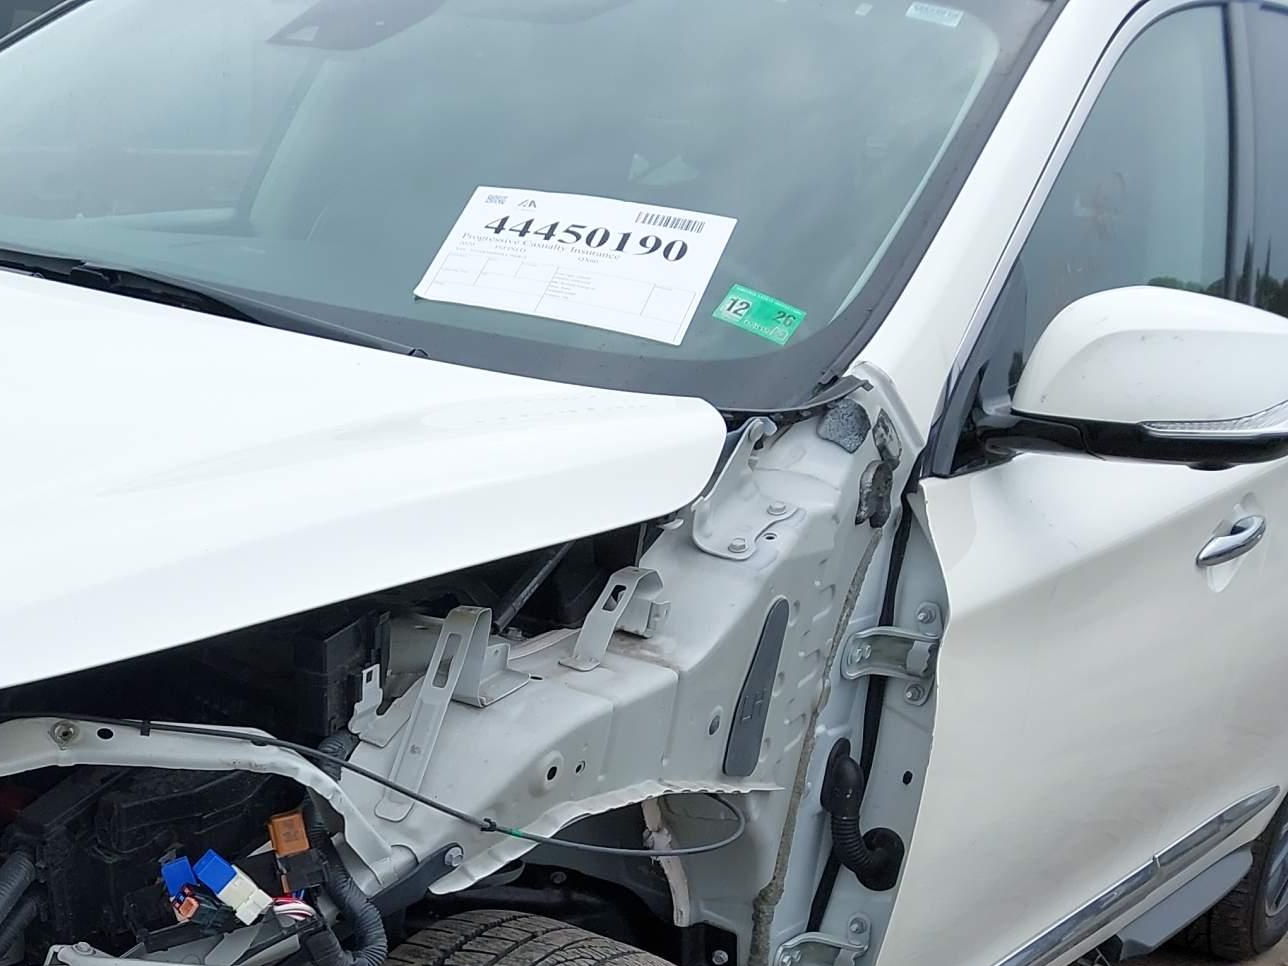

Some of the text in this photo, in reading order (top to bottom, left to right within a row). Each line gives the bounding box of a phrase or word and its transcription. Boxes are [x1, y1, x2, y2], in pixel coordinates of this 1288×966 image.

[462, 232, 520, 246] Progressive
[522, 241, 565, 253] Casualty
[570, 246, 621, 260] Insurance
[484, 215, 689, 263] 44450190
[726, 297, 751, 317] 12
[773, 310, 796, 327] 26
